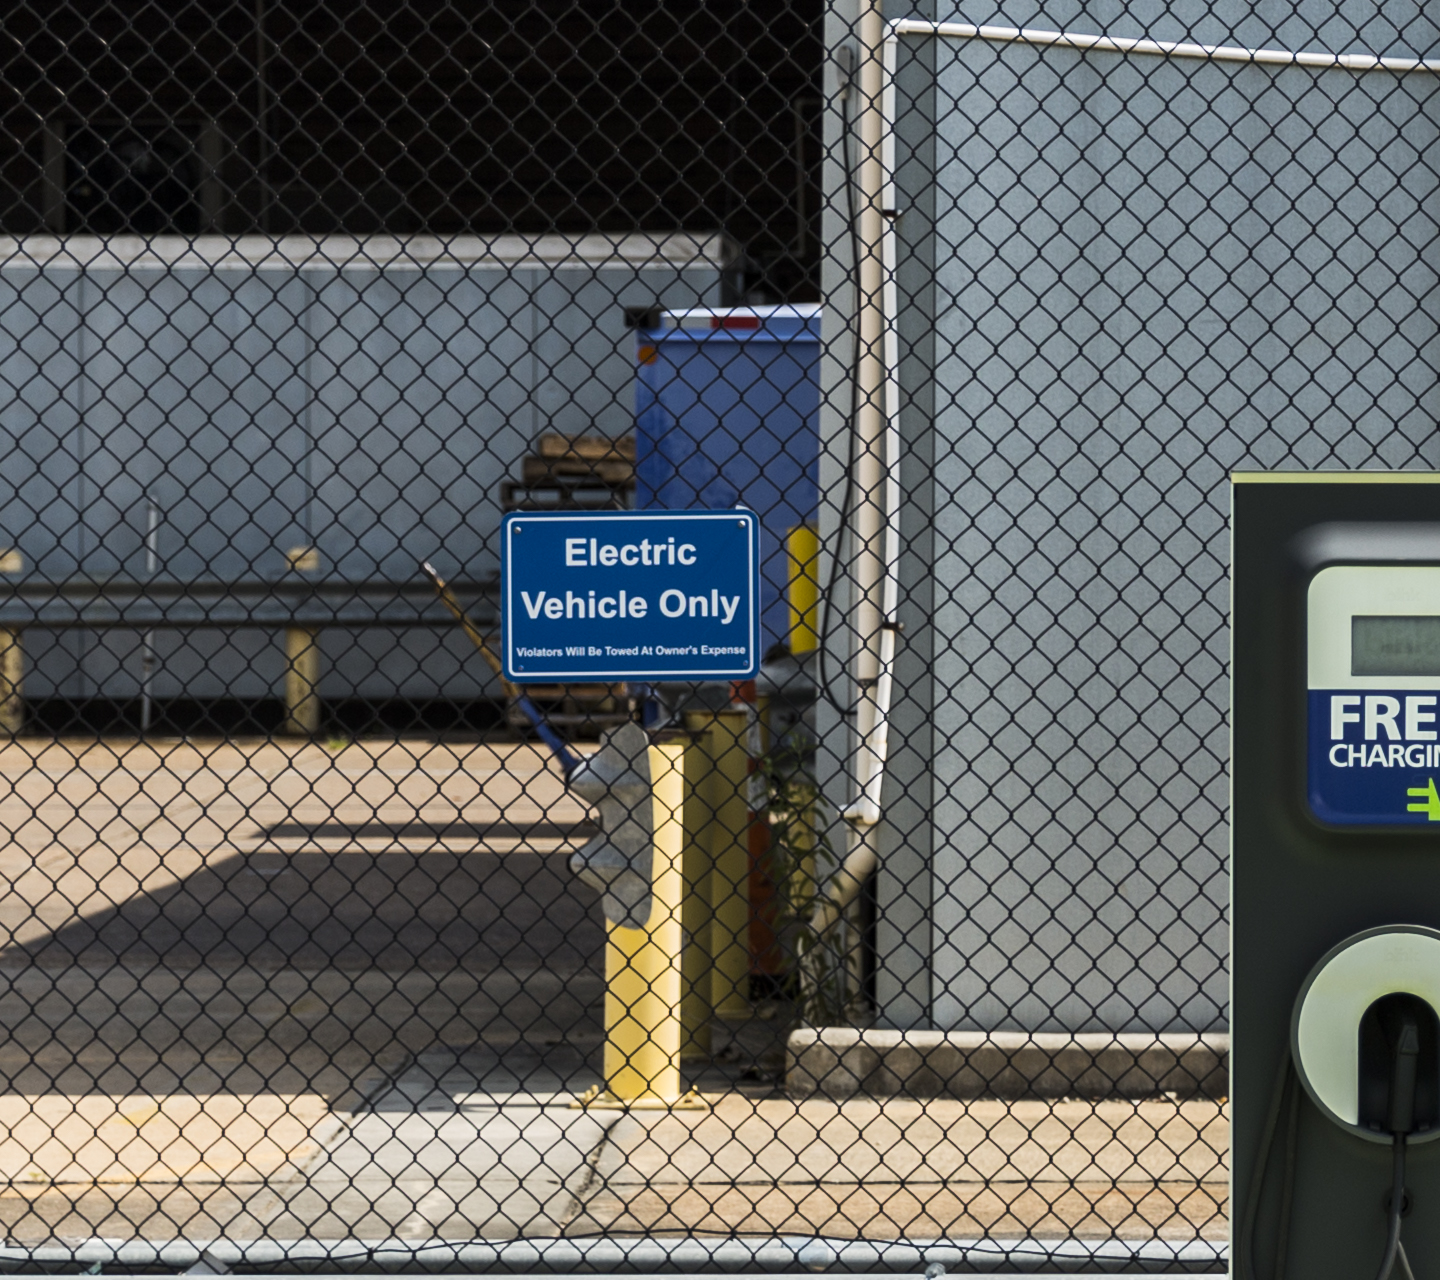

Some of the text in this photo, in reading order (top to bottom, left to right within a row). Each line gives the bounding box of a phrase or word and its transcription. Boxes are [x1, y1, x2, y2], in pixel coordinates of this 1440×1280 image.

[565, 536, 697, 567] Electric
[520, 588, 741, 625] Vehicle Only
[516, 644, 746, 658] Violators Will Be Towed At Owner's Expense
